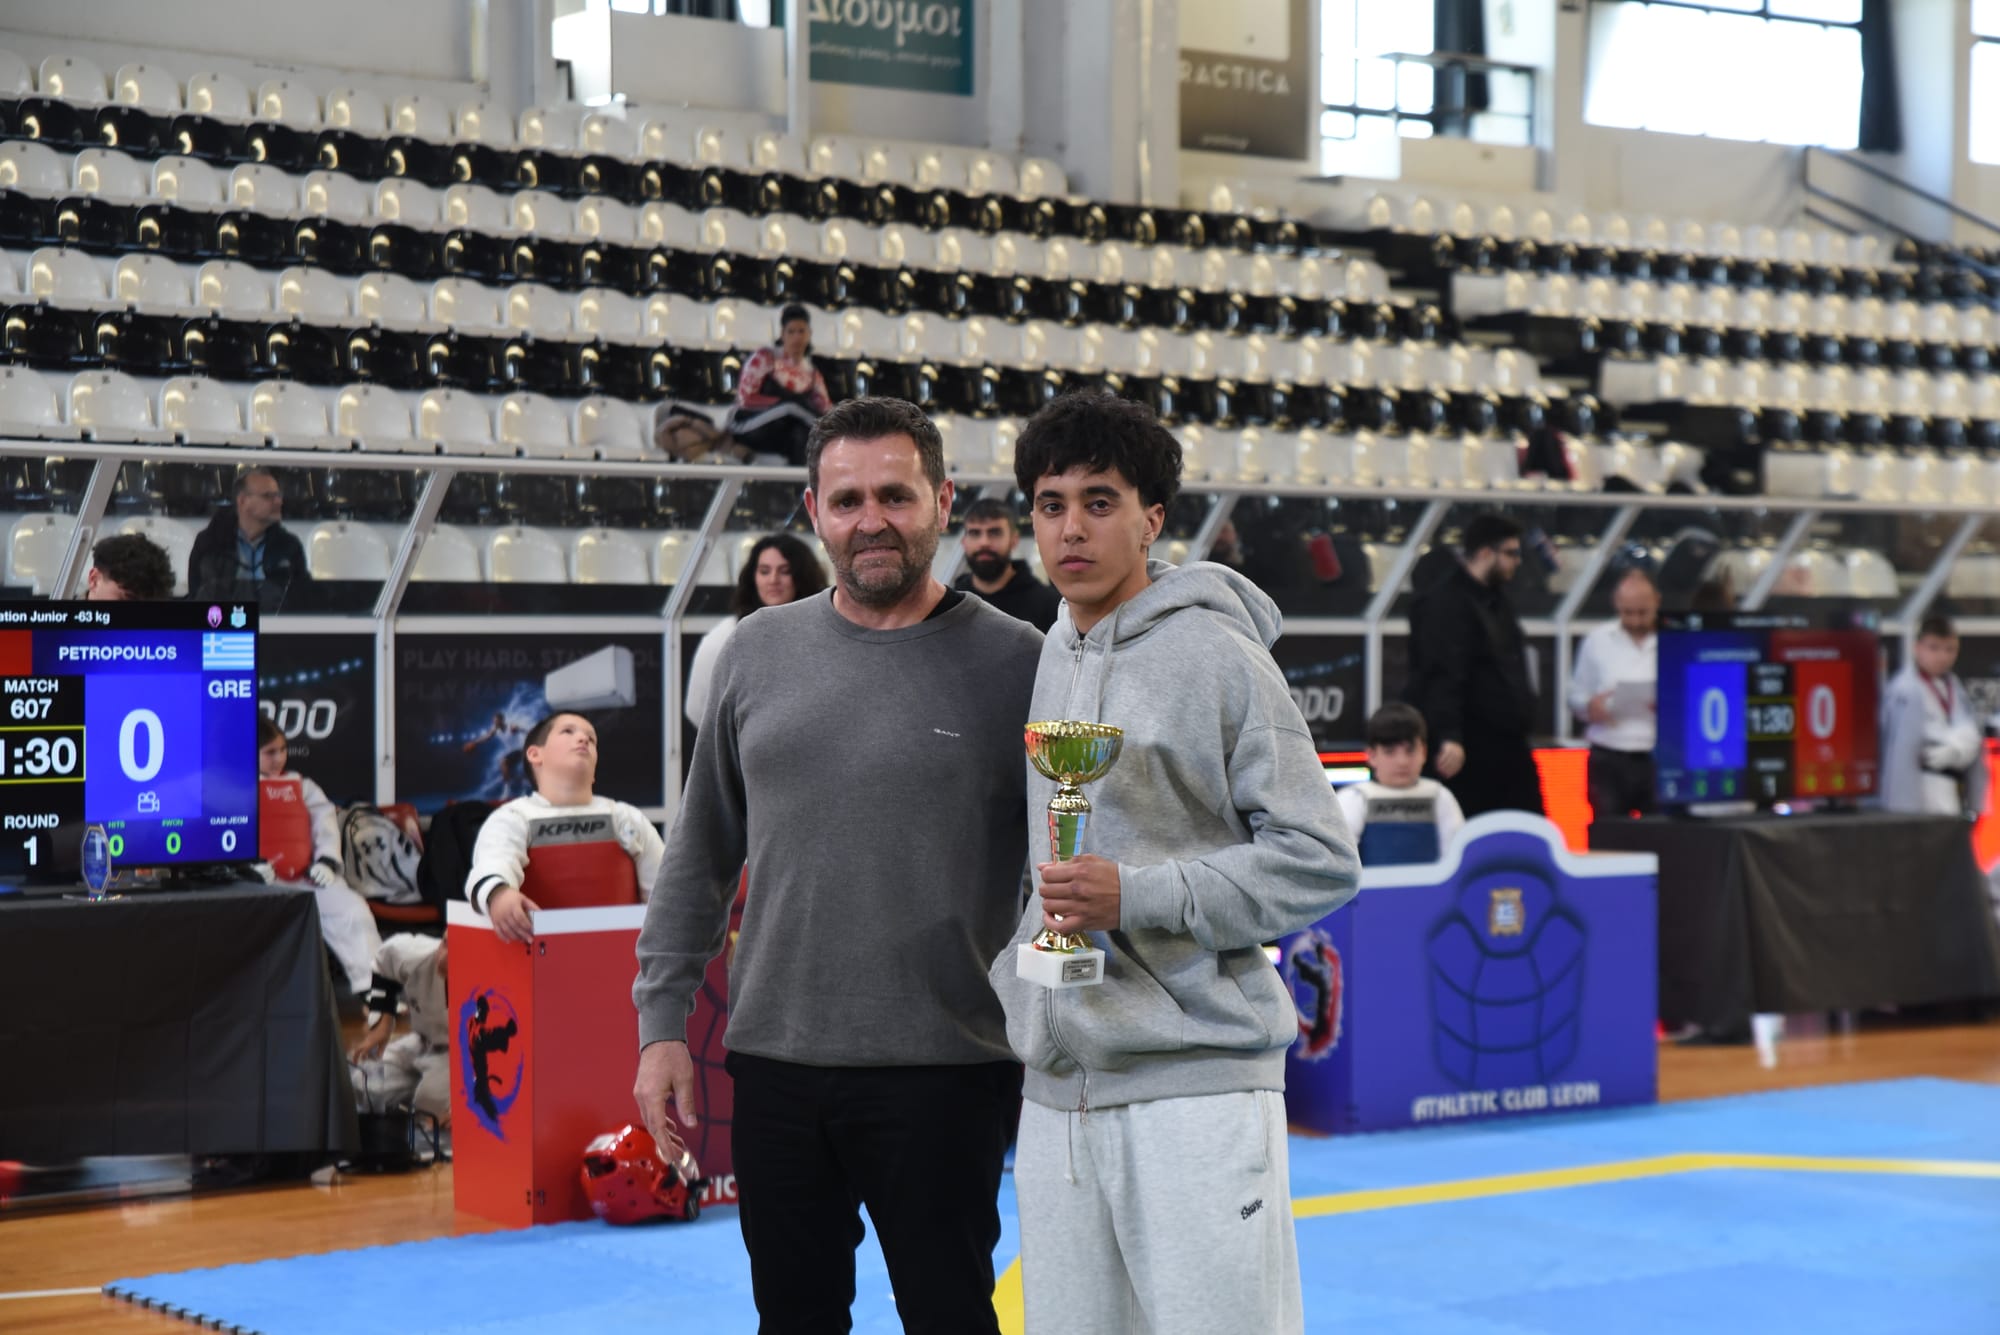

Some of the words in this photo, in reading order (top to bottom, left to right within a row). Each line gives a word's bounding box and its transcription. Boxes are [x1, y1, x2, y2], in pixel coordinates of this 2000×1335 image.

[30, 610, 68, 623] Junior
[74, 611, 93, 622] -63
[95, 610, 111, 625] kg
[58, 645, 178, 661] PETROPOULOS
[403, 647, 457, 669] PLAY
[4, 679, 59, 693] MATCH
[208, 680, 252, 698] GRE
[10, 698, 52, 719] 607
[1700, 686, 1729, 743] 0
[1810, 685, 1836, 739] 0
[118, 708, 165, 783] 0
[4, 814, 60, 829] ROUND
[538, 821, 607, 836] KPNP
[23, 836, 38, 866] 1
[109, 834, 125, 857] 0
[166, 831, 182, 855] 0
[221, 829, 237, 852] 0
[1412, 1090, 1499, 1121] ATHLETIC
[1501, 1085, 1548, 1111] CLUB
[1551, 1081, 1601, 1107] LEON
